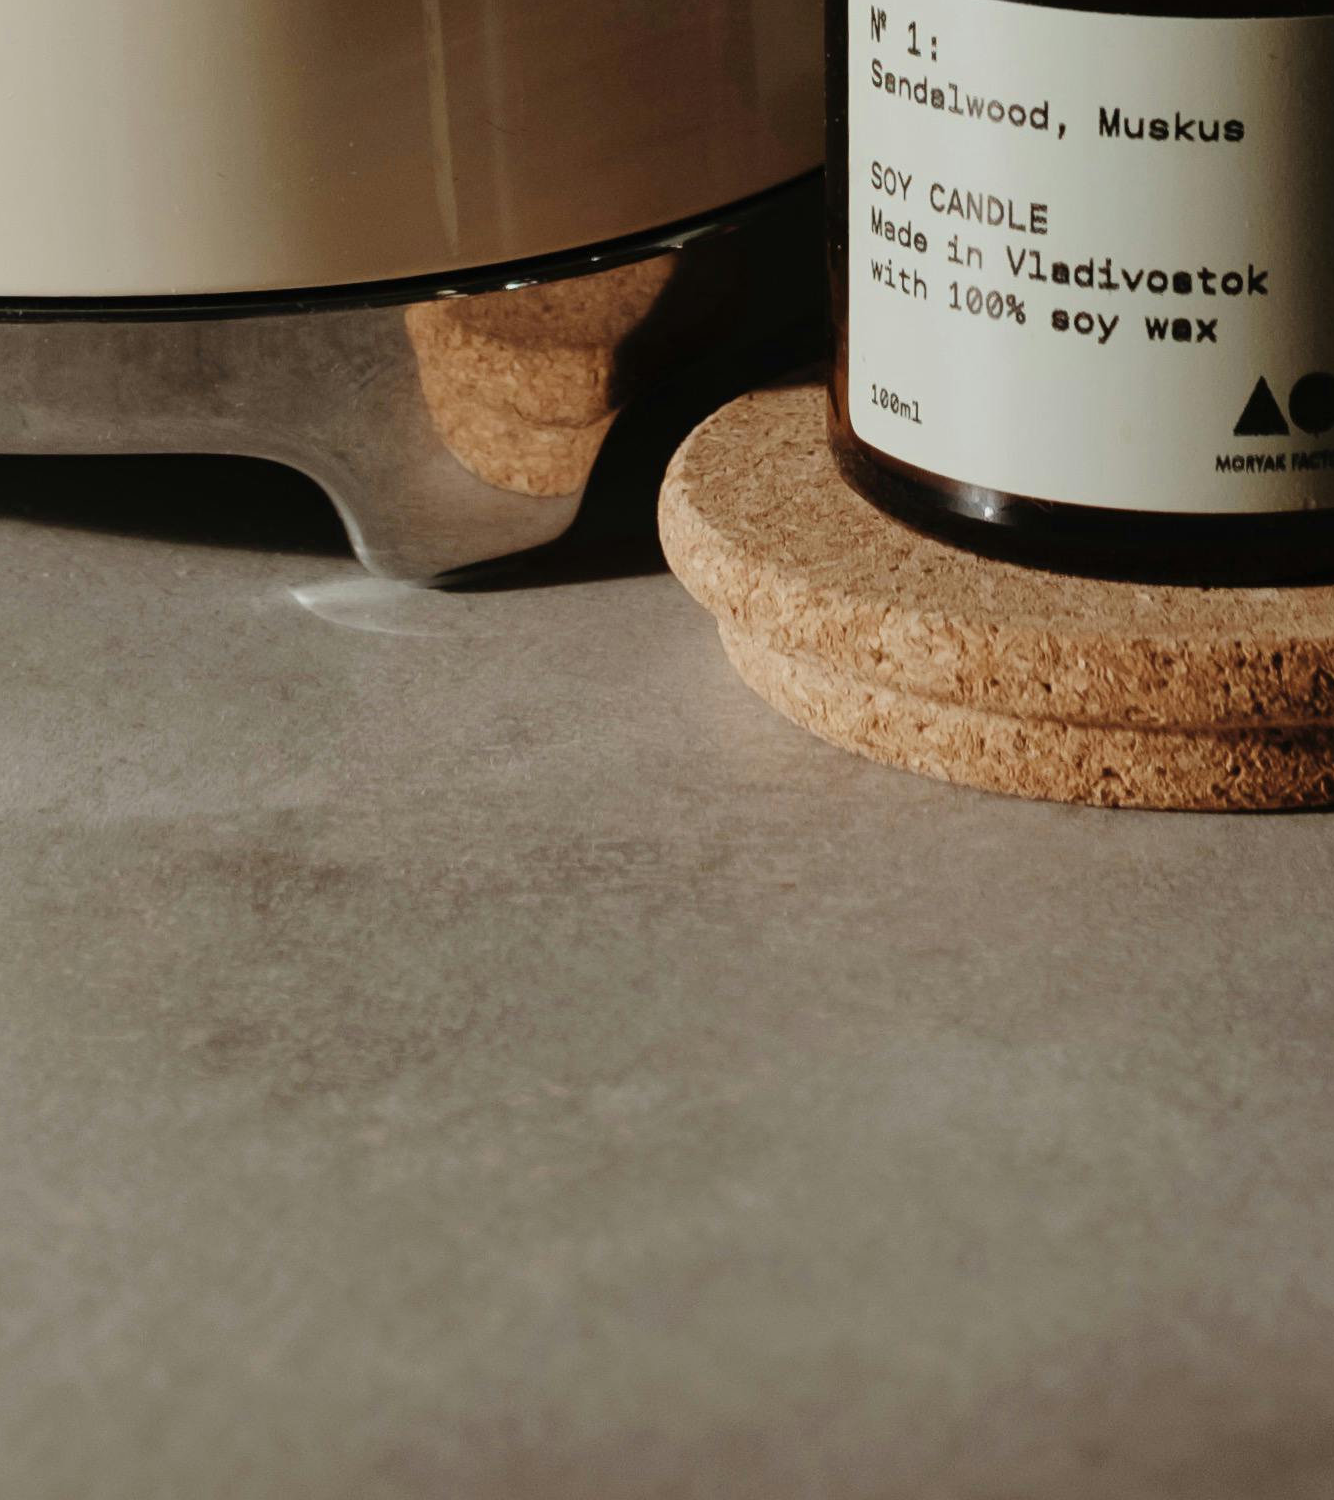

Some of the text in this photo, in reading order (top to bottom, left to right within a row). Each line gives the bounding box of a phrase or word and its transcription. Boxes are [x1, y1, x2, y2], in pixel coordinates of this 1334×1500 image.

[907, 21, 938, 62] 1:
[871, 57, 1246, 144] Sandalwood, Muskus
[871, 160, 1048, 236] SOY CANDLE
[871, 205, 1269, 297] Made in Vladivostok
[870, 259, 1219, 345] with 100% soy wax
[871, 383, 922, 425] 100ml
[1215, 452, 1287, 475] MORYAK
